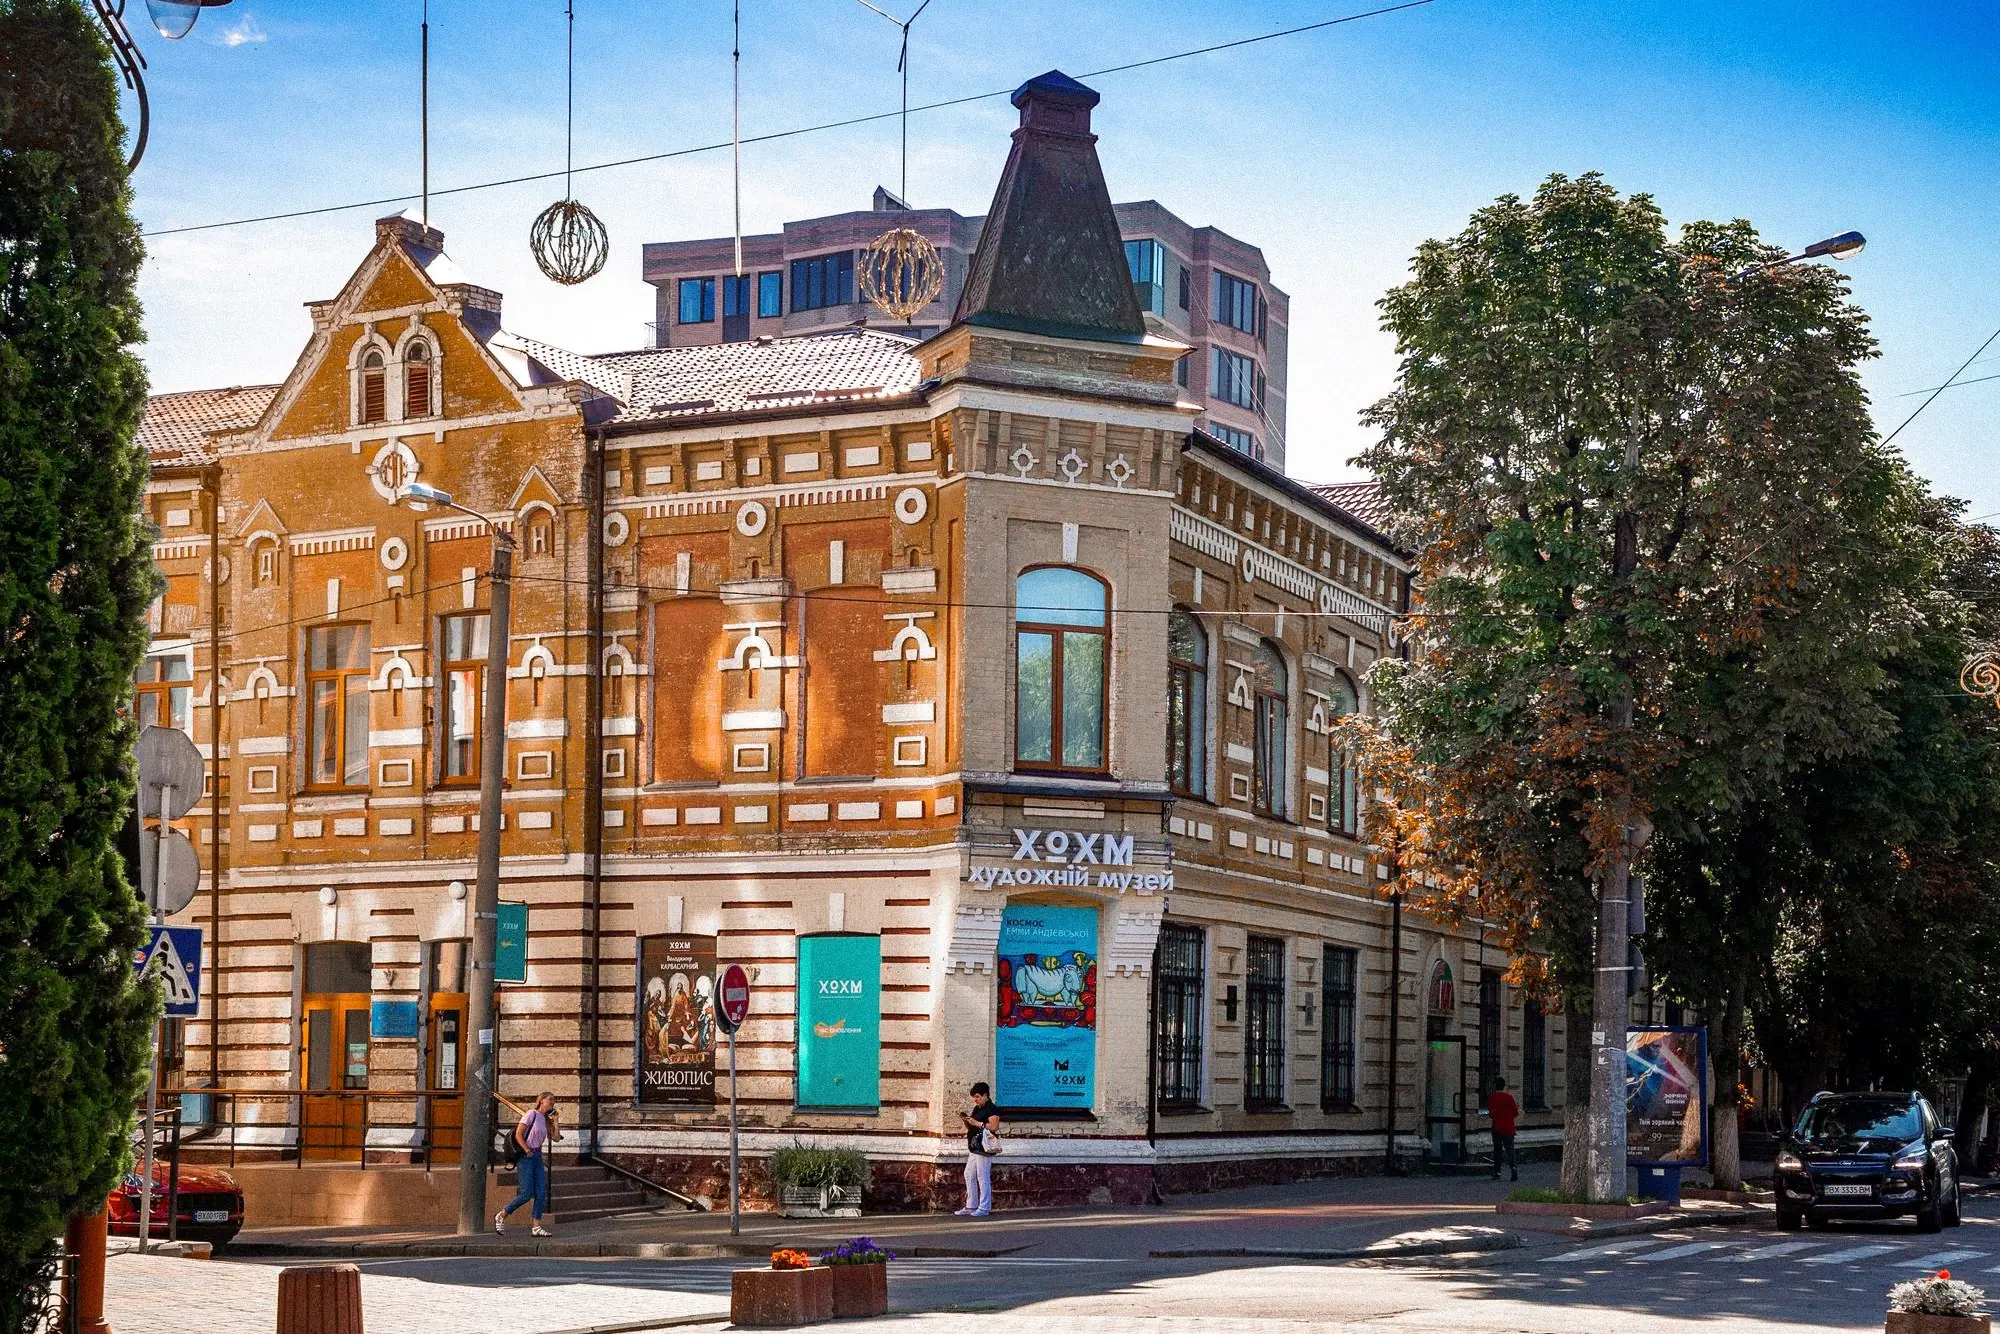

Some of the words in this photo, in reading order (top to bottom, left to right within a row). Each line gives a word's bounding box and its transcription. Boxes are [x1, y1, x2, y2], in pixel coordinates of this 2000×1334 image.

[1013, 828, 1134, 866] ХОХМ
[968, 864, 1089, 888] художній
[1098, 869, 1174, 894] музей
[1006, 919, 1045, 928] КОСМОС
[669, 941, 691, 949] ХОХМ
[818, 979, 863, 994] ХОХМ
[644, 1070, 713, 1086] ЖИВОПИС
[1054, 1075, 1086, 1085] ХОХМ
